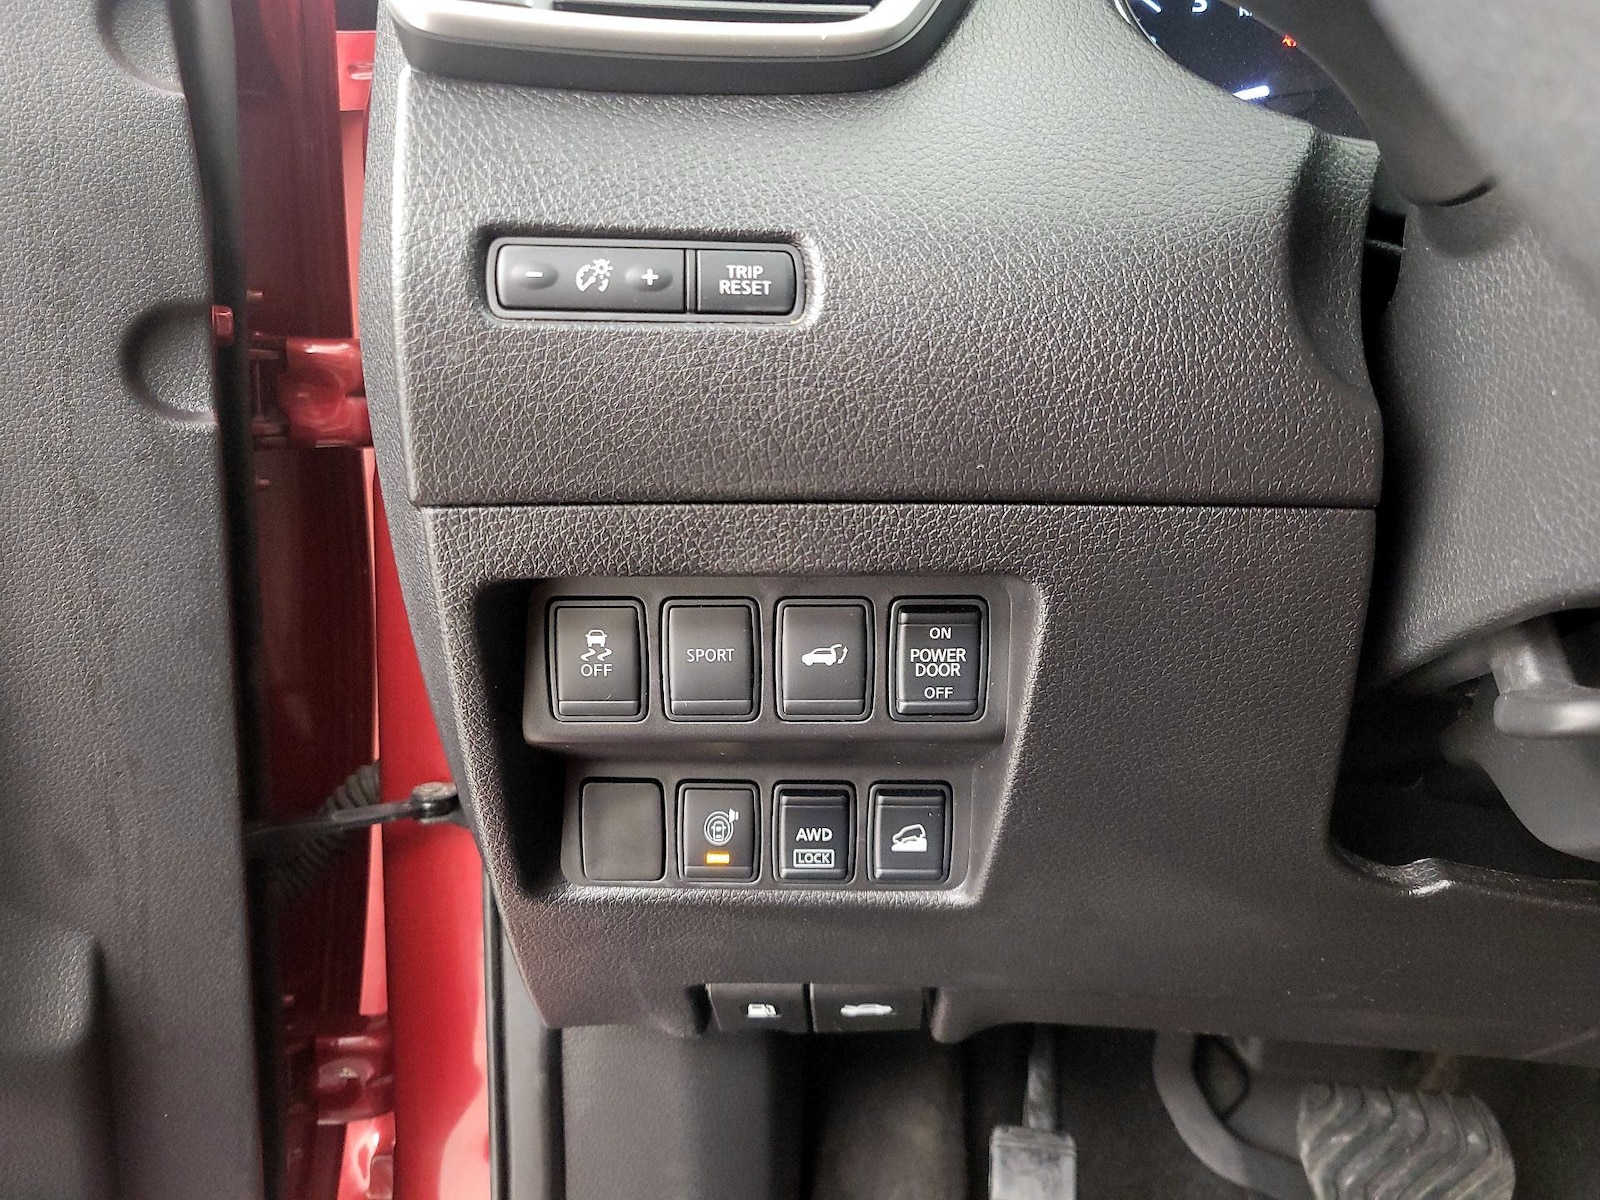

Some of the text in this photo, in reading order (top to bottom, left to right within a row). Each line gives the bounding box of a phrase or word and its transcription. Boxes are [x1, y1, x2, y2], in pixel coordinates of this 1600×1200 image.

[726, 264, 764, 279] TRIP
[718, 279, 772, 296] RESET
[929, 627, 952, 640] ON
[686, 648, 735, 663] SPORT
[910, 648, 967, 663] POWER
[580, 663, 613, 677] OFF
[915, 662, 961, 678] DOOR
[924, 686, 954, 699] OFF
[796, 827, 833, 842] AWD
[798, 852, 830, 865] LOCK
